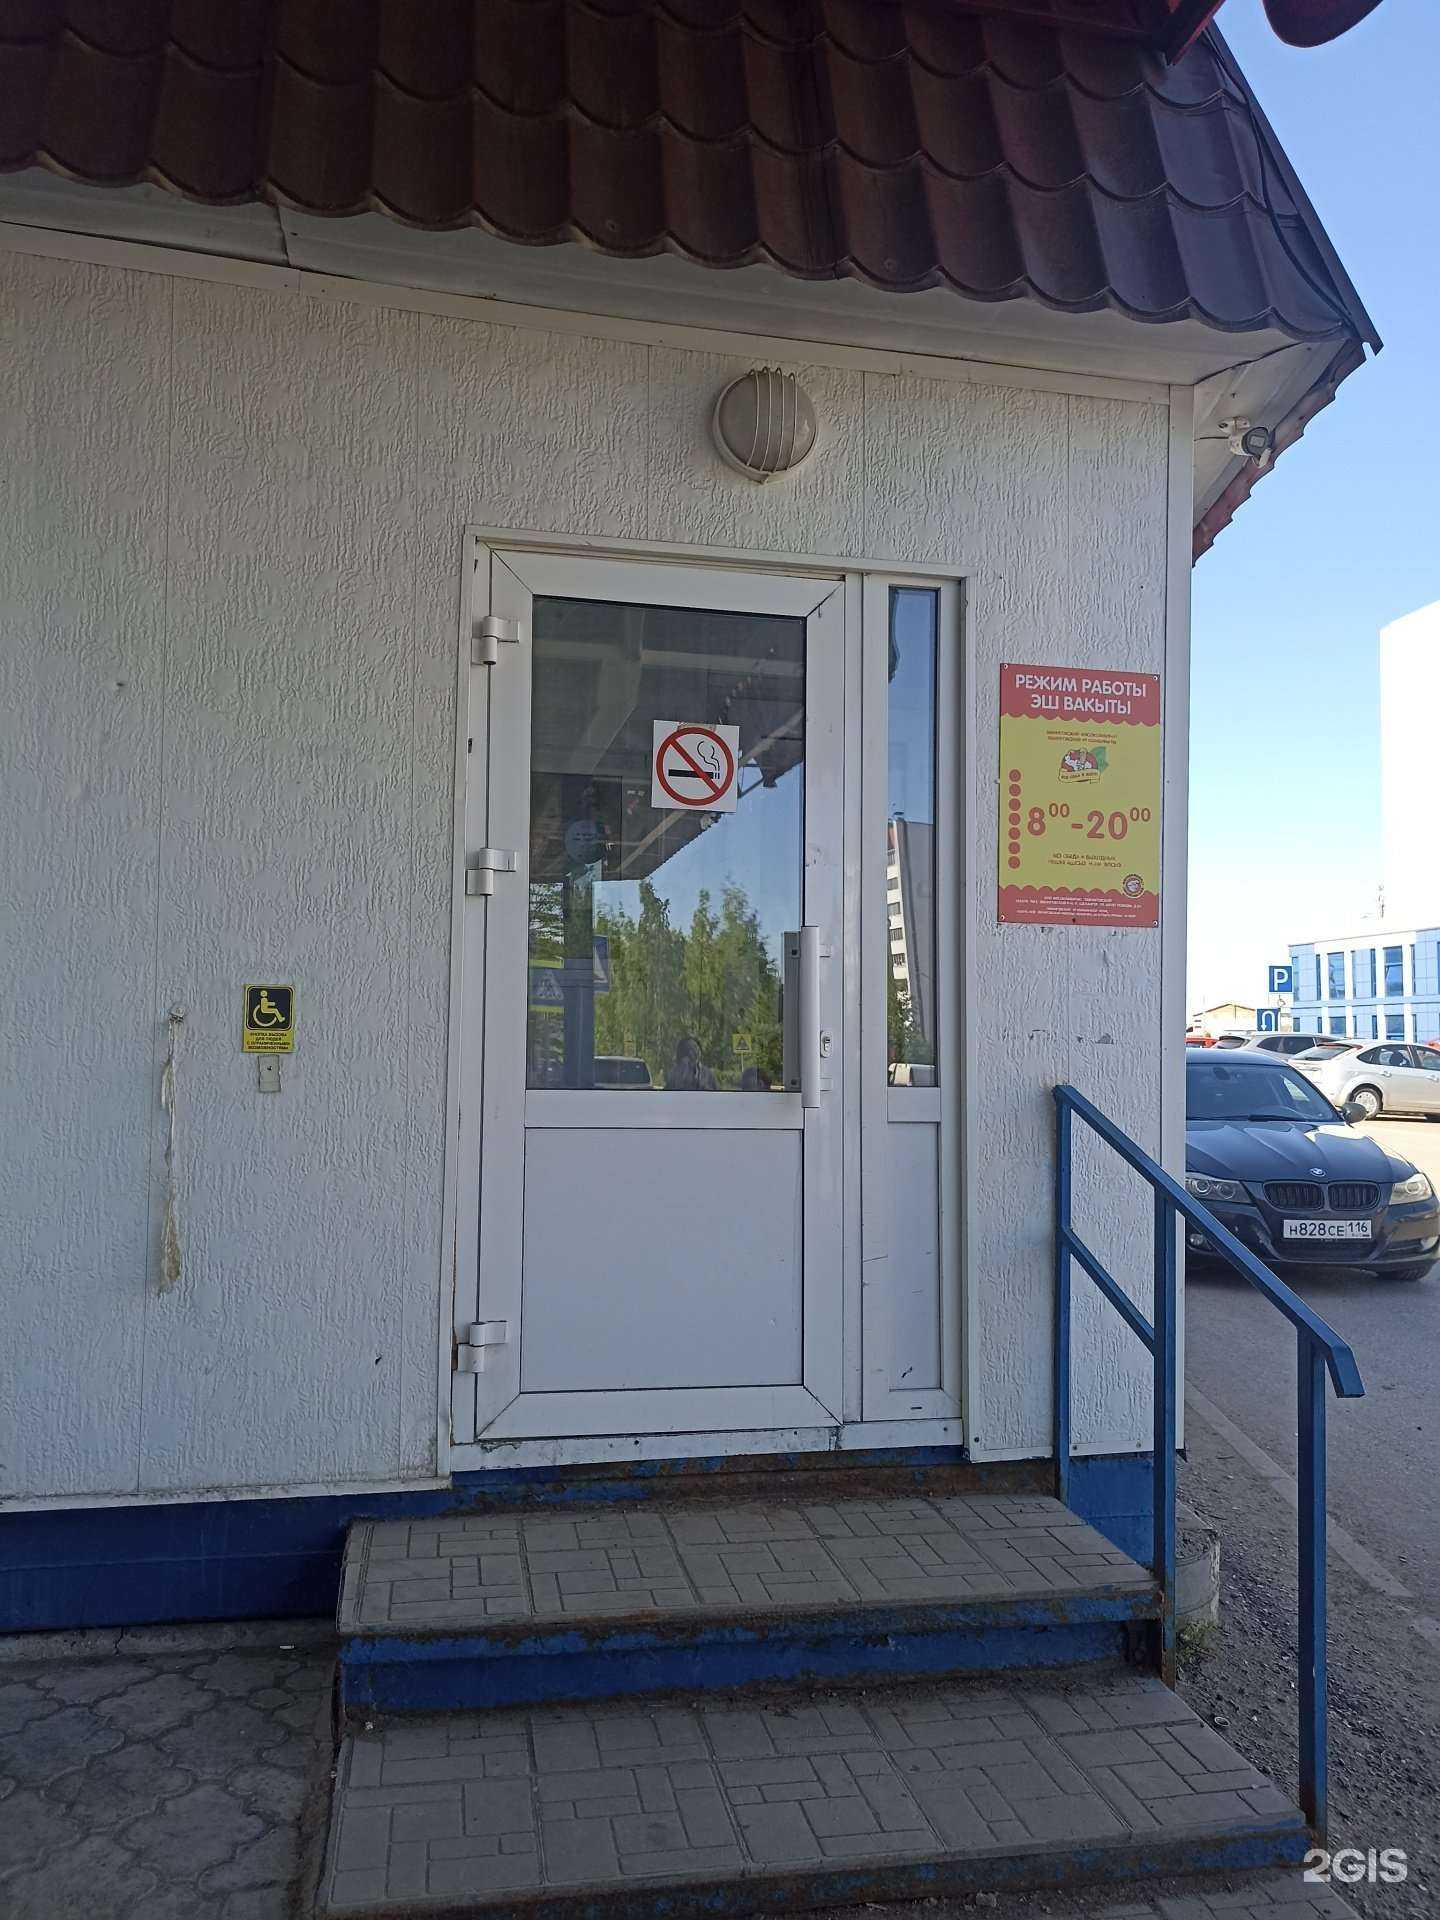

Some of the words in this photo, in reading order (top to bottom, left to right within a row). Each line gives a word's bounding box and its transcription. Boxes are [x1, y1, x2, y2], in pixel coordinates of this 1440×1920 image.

[1015, 674, 1077, 692] РЕЖИМ
[1082, 679, 1146, 697] РАБОТЫ
[1030, 694, 1059, 710] ЭШ
[1064, 697, 1131, 714] ВАКЫТЫ
[1347, 1222, 1368, 1233] 116
